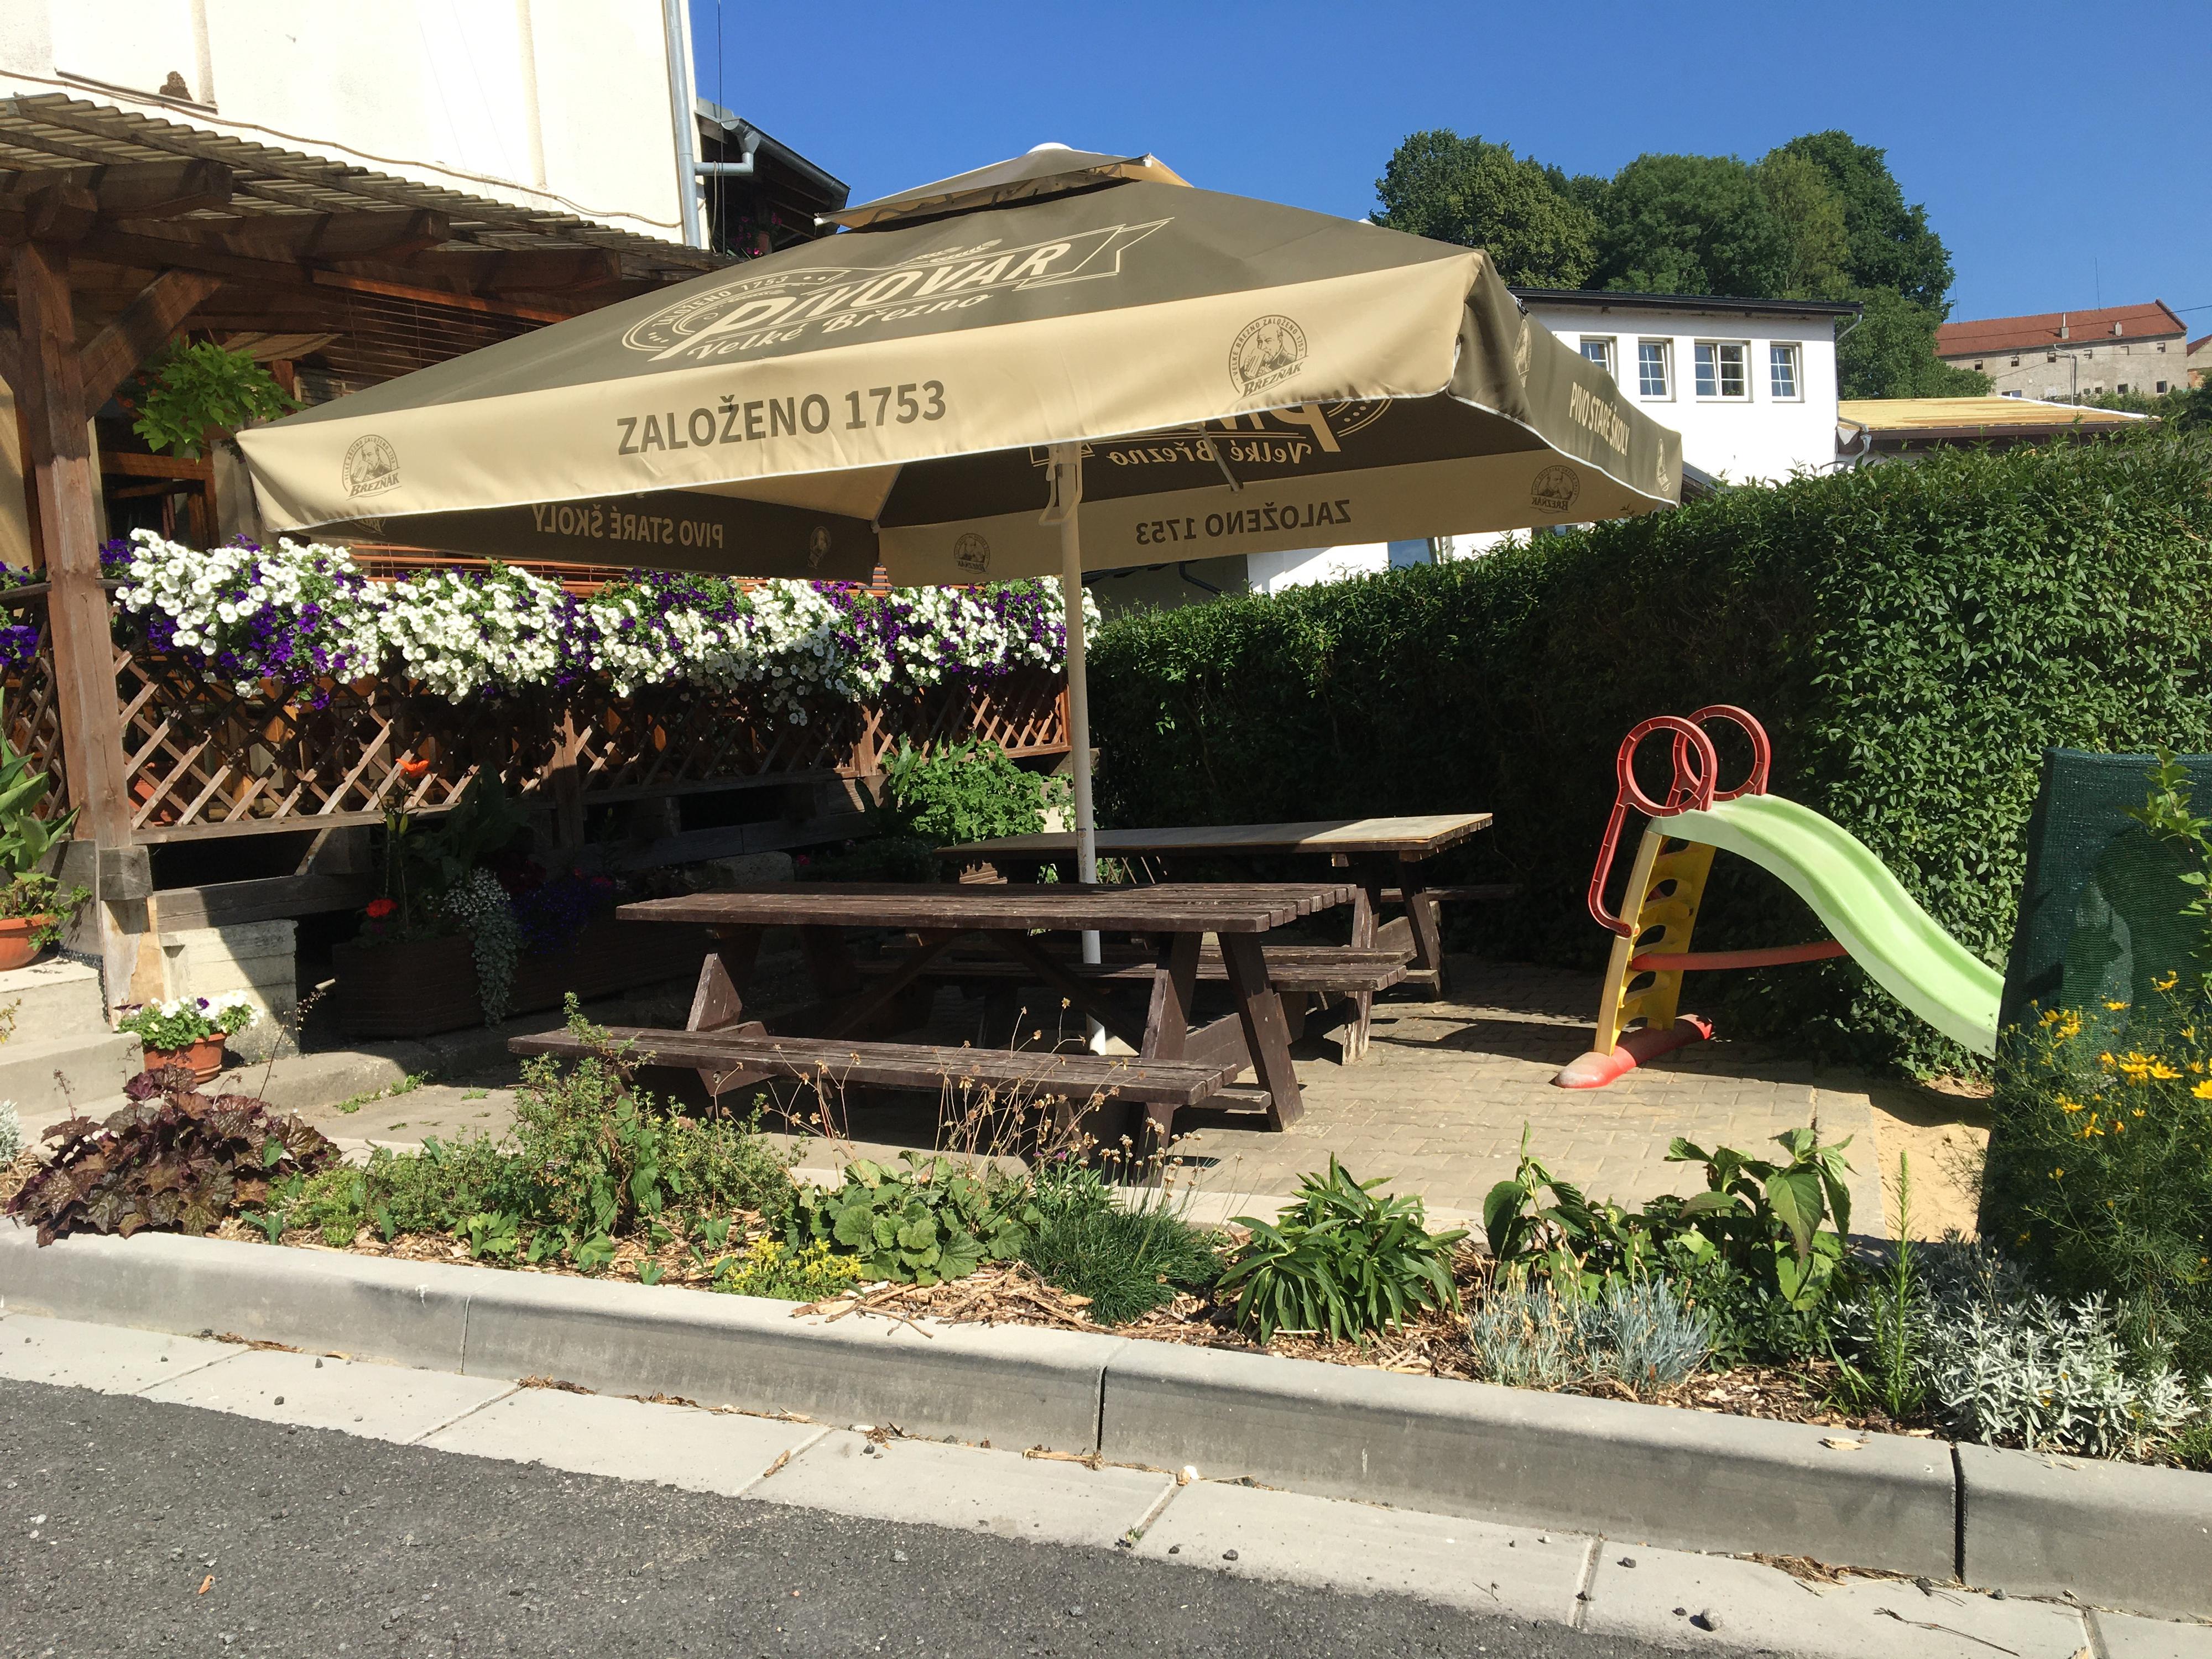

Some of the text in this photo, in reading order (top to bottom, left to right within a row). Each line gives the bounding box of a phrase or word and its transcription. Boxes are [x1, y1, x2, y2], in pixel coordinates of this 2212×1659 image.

[647, 242, 1072, 362] PIVOVAR
[741, 276, 789, 290] 1753
[687, 294, 993, 359] Velké Březno
[1263, 318, 1298, 335] ZALOŽENO
[1242, 361, 1304, 398] BŘEZŇÁK
[617, 380, 946, 455] ZALOŽENO 1753
[1569, 382, 1630, 456] PIVO STARÉ ŠKOLY
[348, 472, 399, 497] BŘEZŇÁK
